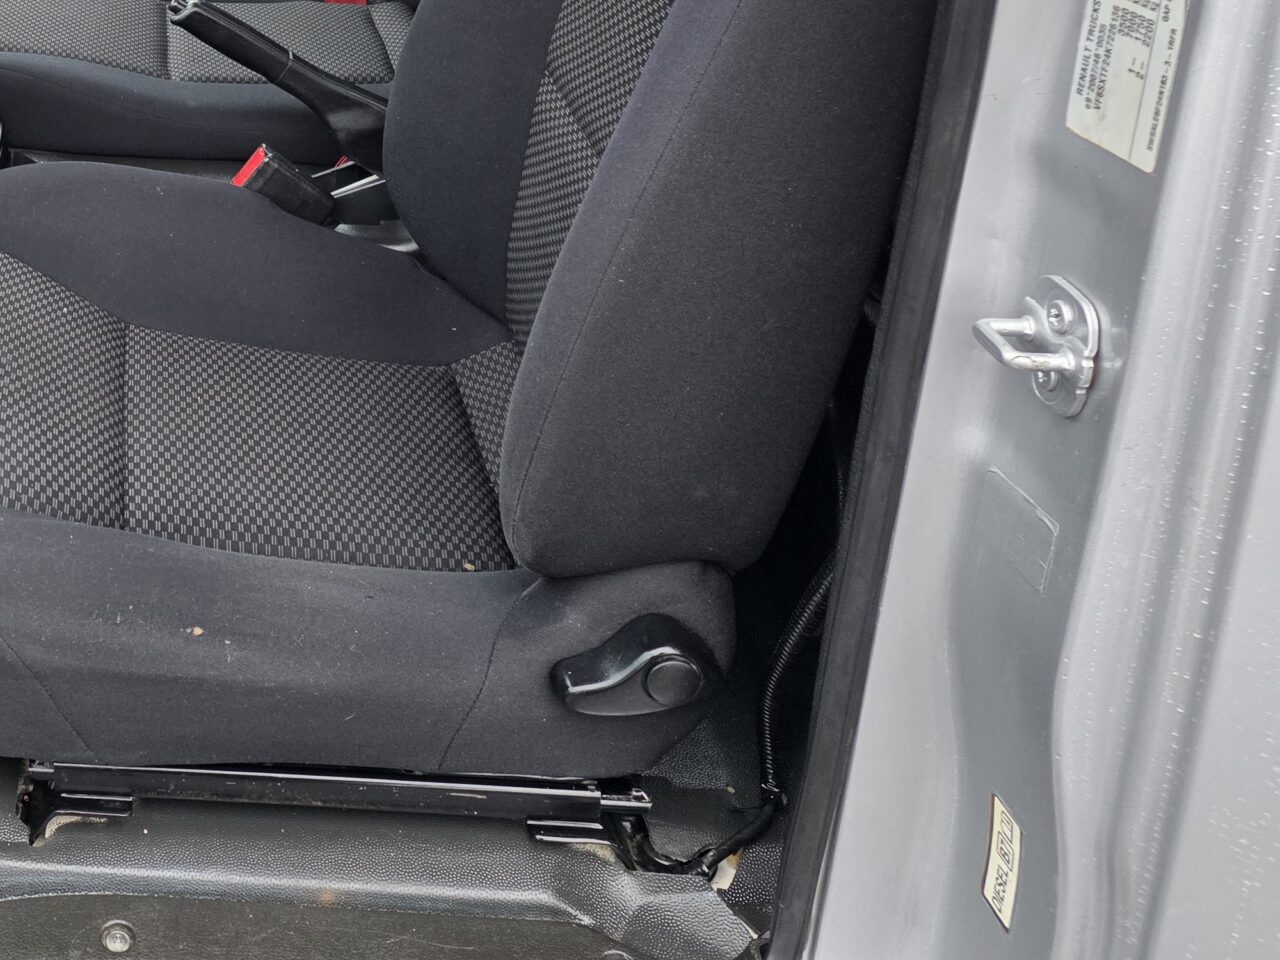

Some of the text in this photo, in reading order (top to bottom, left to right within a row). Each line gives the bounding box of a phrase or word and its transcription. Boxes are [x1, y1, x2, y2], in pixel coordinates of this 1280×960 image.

[1117, 7, 1130, 38] 3500
[1126, 11, 1138, 39] 7000
[1134, 14, 1147, 41] 1750
[1142, 18, 1155, 48] 2200
[1076, 0, 1102, 96] RENAULT TRUCKS
[991, 839, 1011, 913] DIESEL B7
